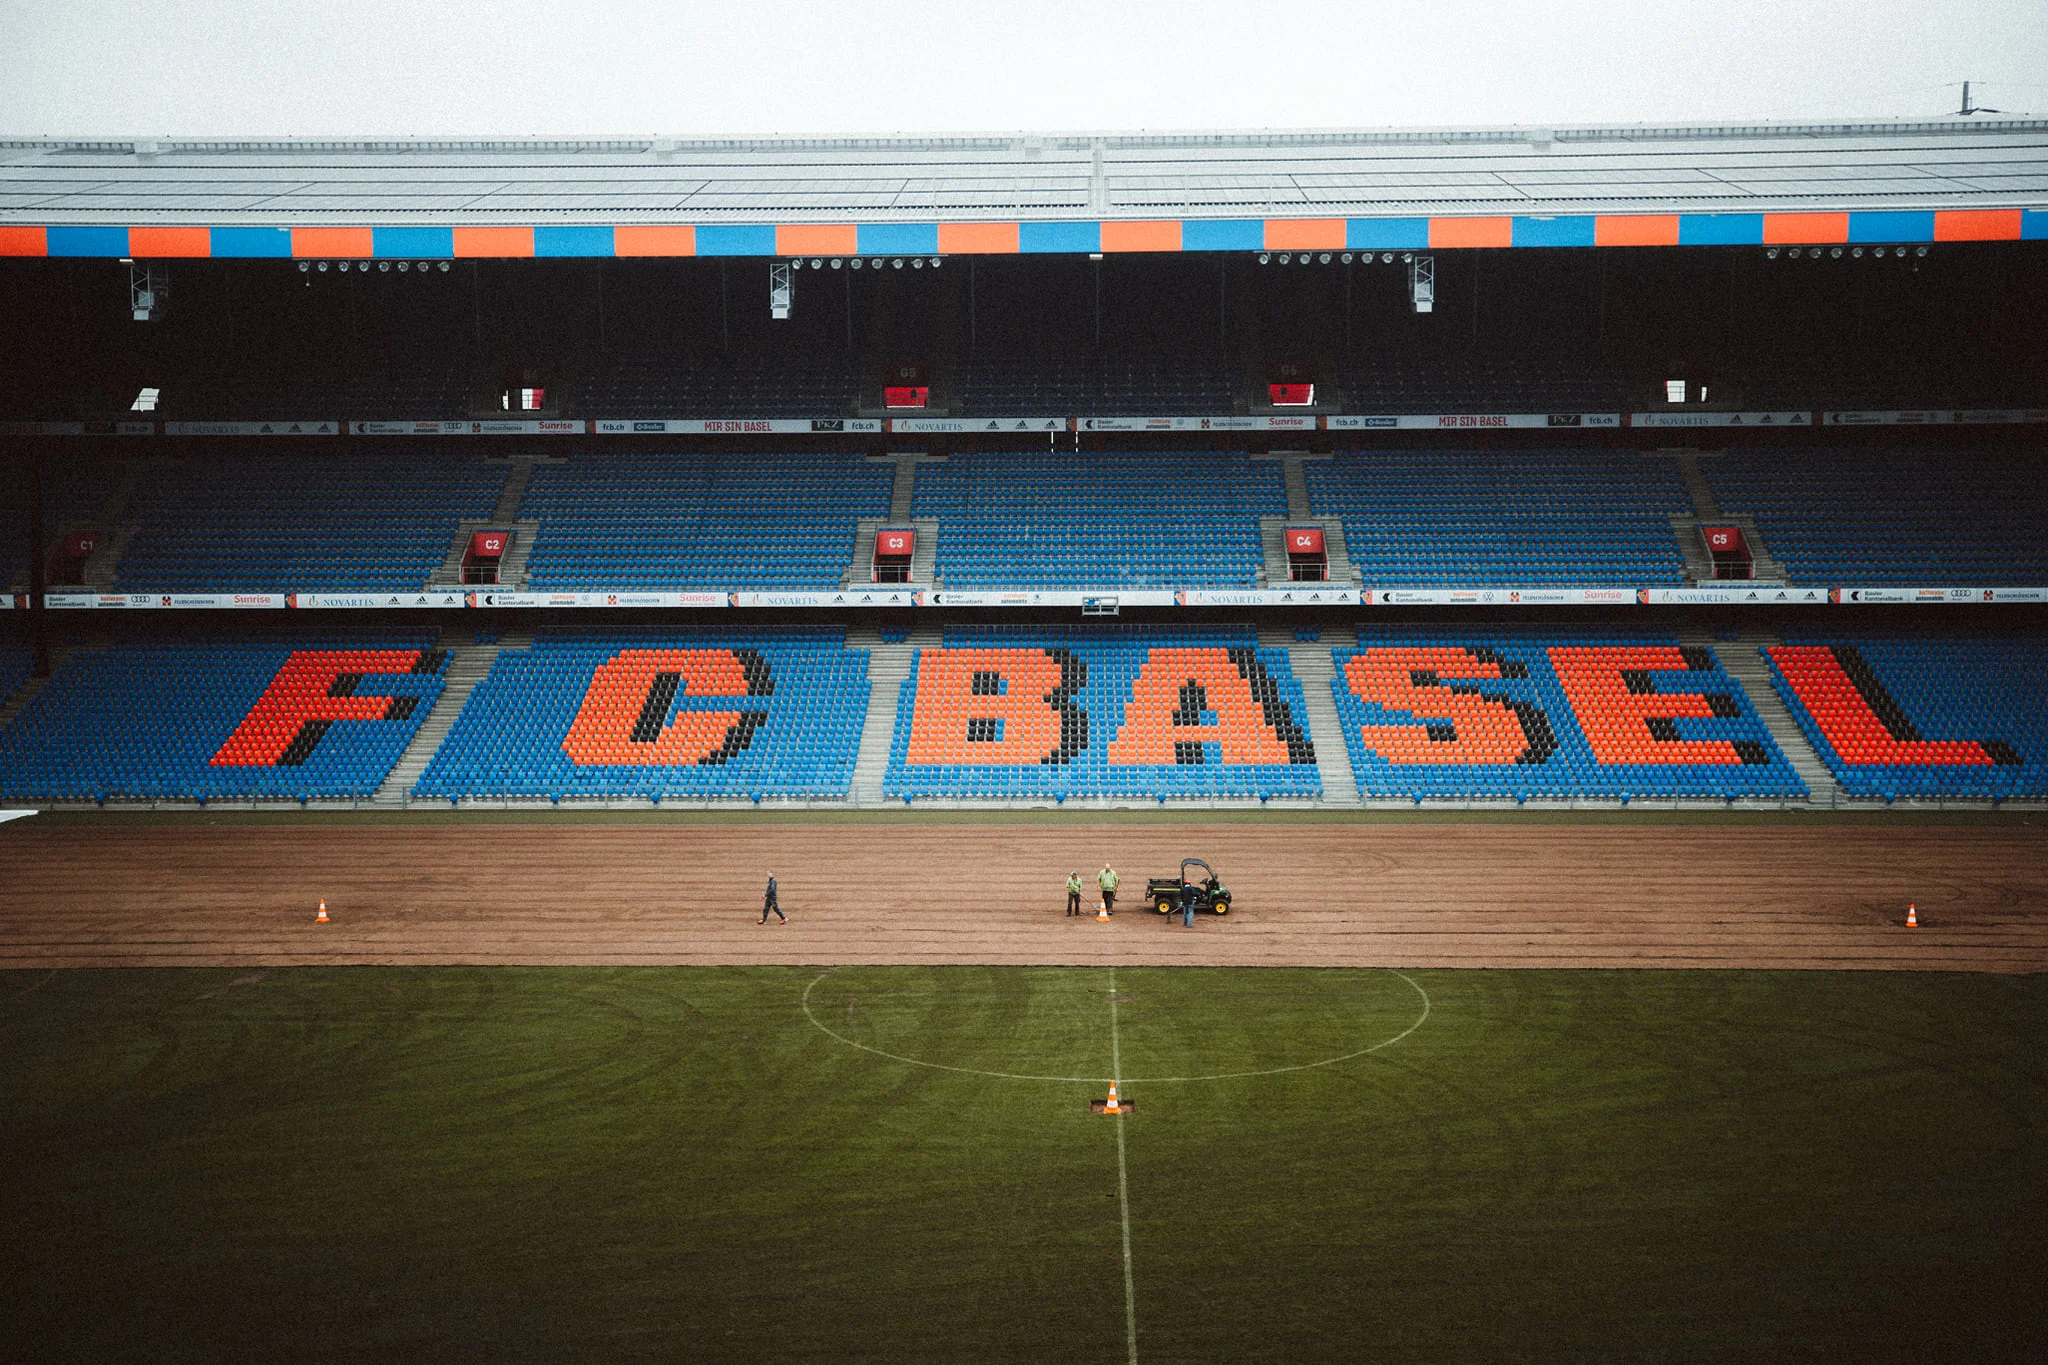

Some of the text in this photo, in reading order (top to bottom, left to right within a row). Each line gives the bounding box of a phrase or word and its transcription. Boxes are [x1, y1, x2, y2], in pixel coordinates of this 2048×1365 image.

[1269, 417, 1304, 425] Sunrise
[1336, 418, 1358, 426] fcb.ch
[1439, 416, 1508, 427] MIR SIN BASEL
[1589, 416, 1613, 425] fcb.ch
[1659, 417, 1709, 425] NOVARTIS
[539, 421, 573, 430] Sunrise
[602, 423, 625, 431] fcb.ch
[704, 421, 772, 432] MIR SIN BASEL
[852, 422, 874, 430] fcb.ch
[915, 423, 963, 431] NOVARTIS
[889, 538, 904, 548] C3
[1296, 536, 1311, 547] C4
[1712, 534, 1727, 545] C5
[80, 540, 94, 551] C1
[485, 539, 500, 550] C2
[679, 594, 716, 602] Sunrise
[1584, 590, 1622, 599] Sunrise
[1678, 594, 1730, 602] NOVARTIS
[234, 595, 270, 603] Sunrise
[324, 598, 374, 606] NOVARTIS
[767, 597, 818, 605] NOVARTIS
[1211, 596, 1262, 604] NOVARTIS
